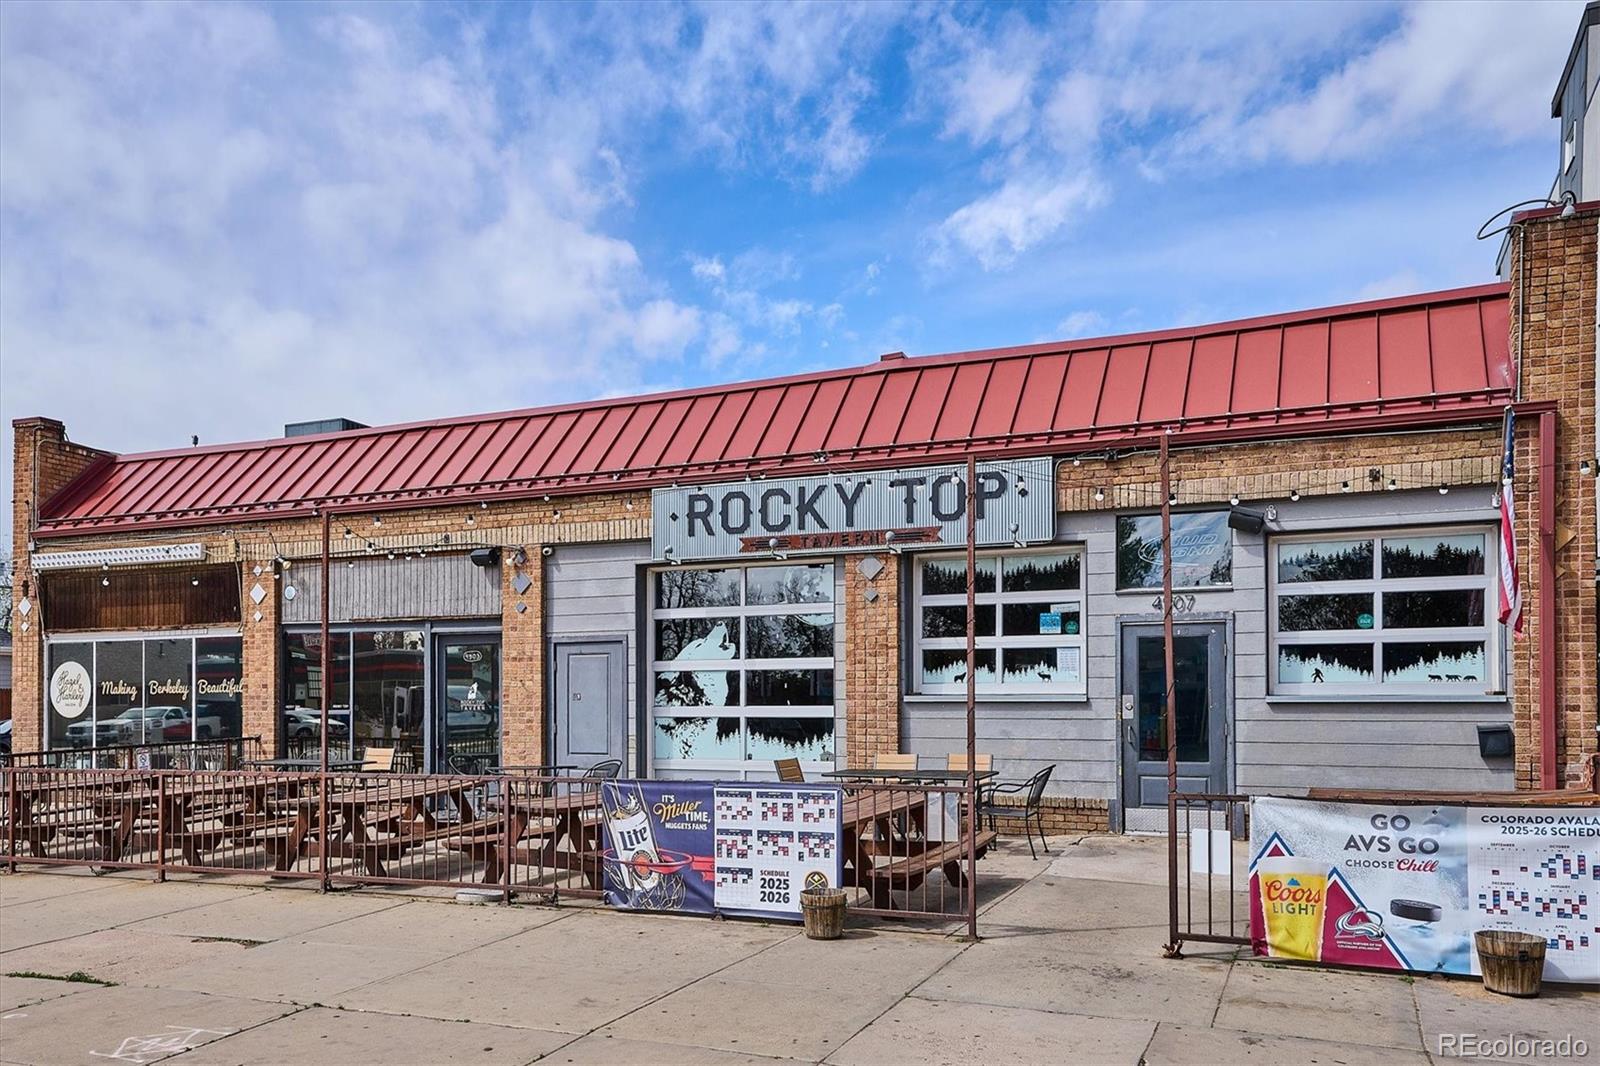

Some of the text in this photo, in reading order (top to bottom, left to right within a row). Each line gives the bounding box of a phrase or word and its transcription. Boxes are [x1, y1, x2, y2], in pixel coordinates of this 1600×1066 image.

[686, 470, 1009, 538] ROCKY TOP
[800, 532, 881, 548] TAVERN
[1152, 594, 1196, 613] 407
[101, 677, 243, 701] Making Berkeley Beautiful
[661, 794, 675, 803] IT'S
[653, 801, 702, 823] Miller
[685, 811, 711, 823] TIME,
[665, 822, 691, 830] NUGGETS
[1370, 813, 1411, 831] GO
[1481, 815, 1600, 826] COLORADO AVALA
[618, 826, 648, 851] Lite
[1501, 826, 1548, 836] 2025-26
[1343, 834, 1440, 854] AVS GO
[760, 869, 790, 877] SCHEDULE
[1345, 858, 1440, 873] CHOOSE Chill
[760, 877, 790, 890] 2025
[760, 890, 790, 904] 2026
[1265, 879, 1321, 904] Coors
[1272, 902, 1317, 915] LIGHT
